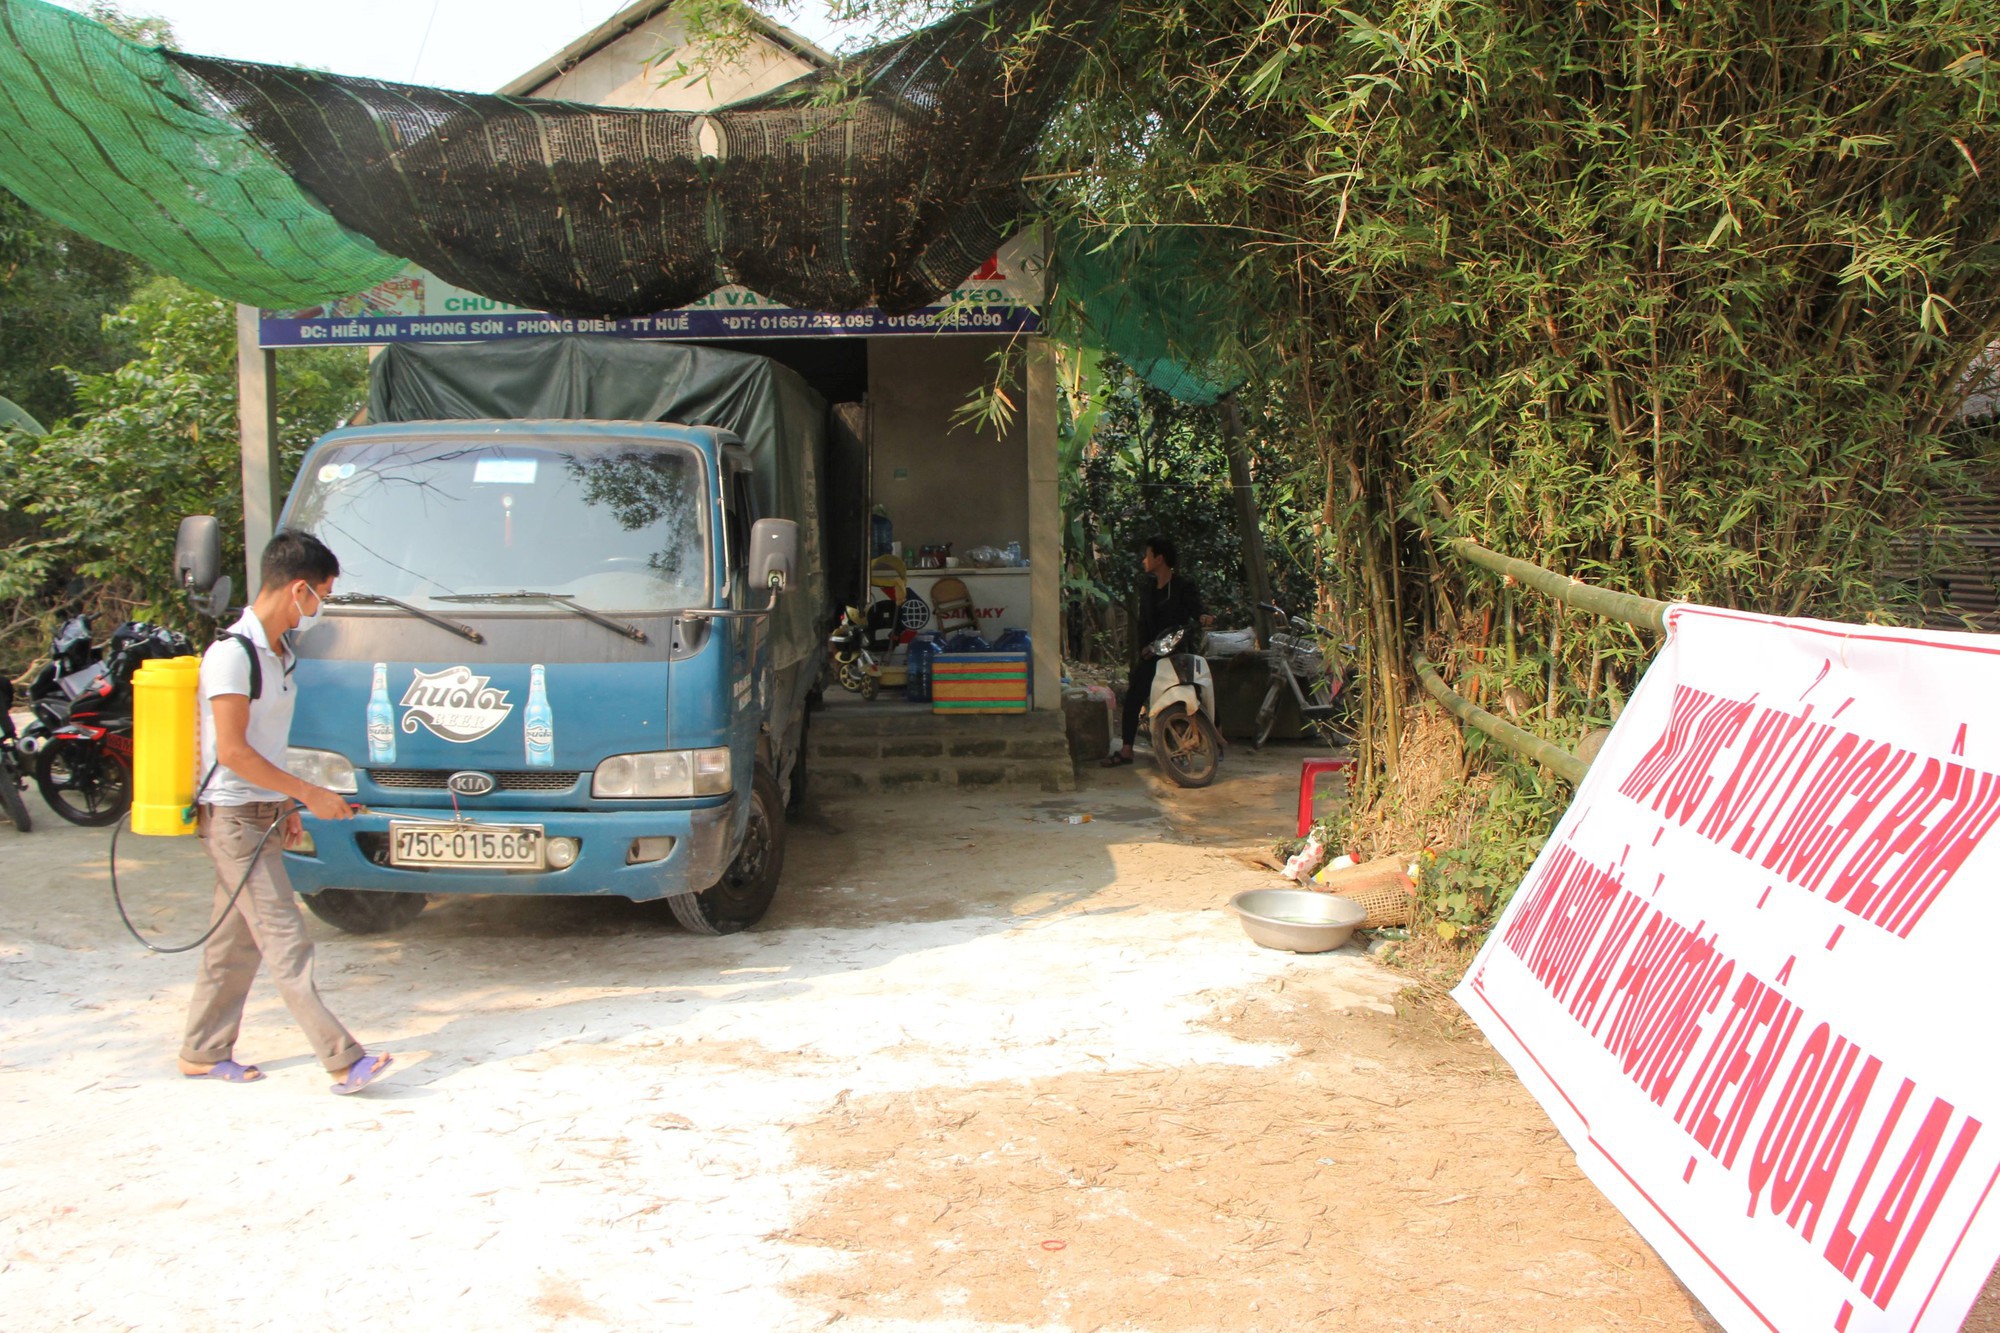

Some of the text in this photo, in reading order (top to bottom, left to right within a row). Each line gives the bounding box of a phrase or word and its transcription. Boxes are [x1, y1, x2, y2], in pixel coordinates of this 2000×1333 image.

[300, 325, 327, 339] ĐC:
[373, 323, 397, 337] AN
[410, 322, 467, 336] PHONG
[470, 319, 504, 335] SƠN
[517, 319, 573, 334] PHONG
[630, 317, 651, 332] TT
[655, 312, 690, 331] HUẾ
[760, 314, 875, 329] 01667.252.095
[431, 713, 486, 729] BEER
[456, 777, 486, 791] KIA
[1824, 722, 2000, 951] BỆNH
[1672, 954, 1805, 1185] TIỆN
[1746, 1022, 1883, 1244] QUA
[1822, 1076, 1983, 1333] LẠI
